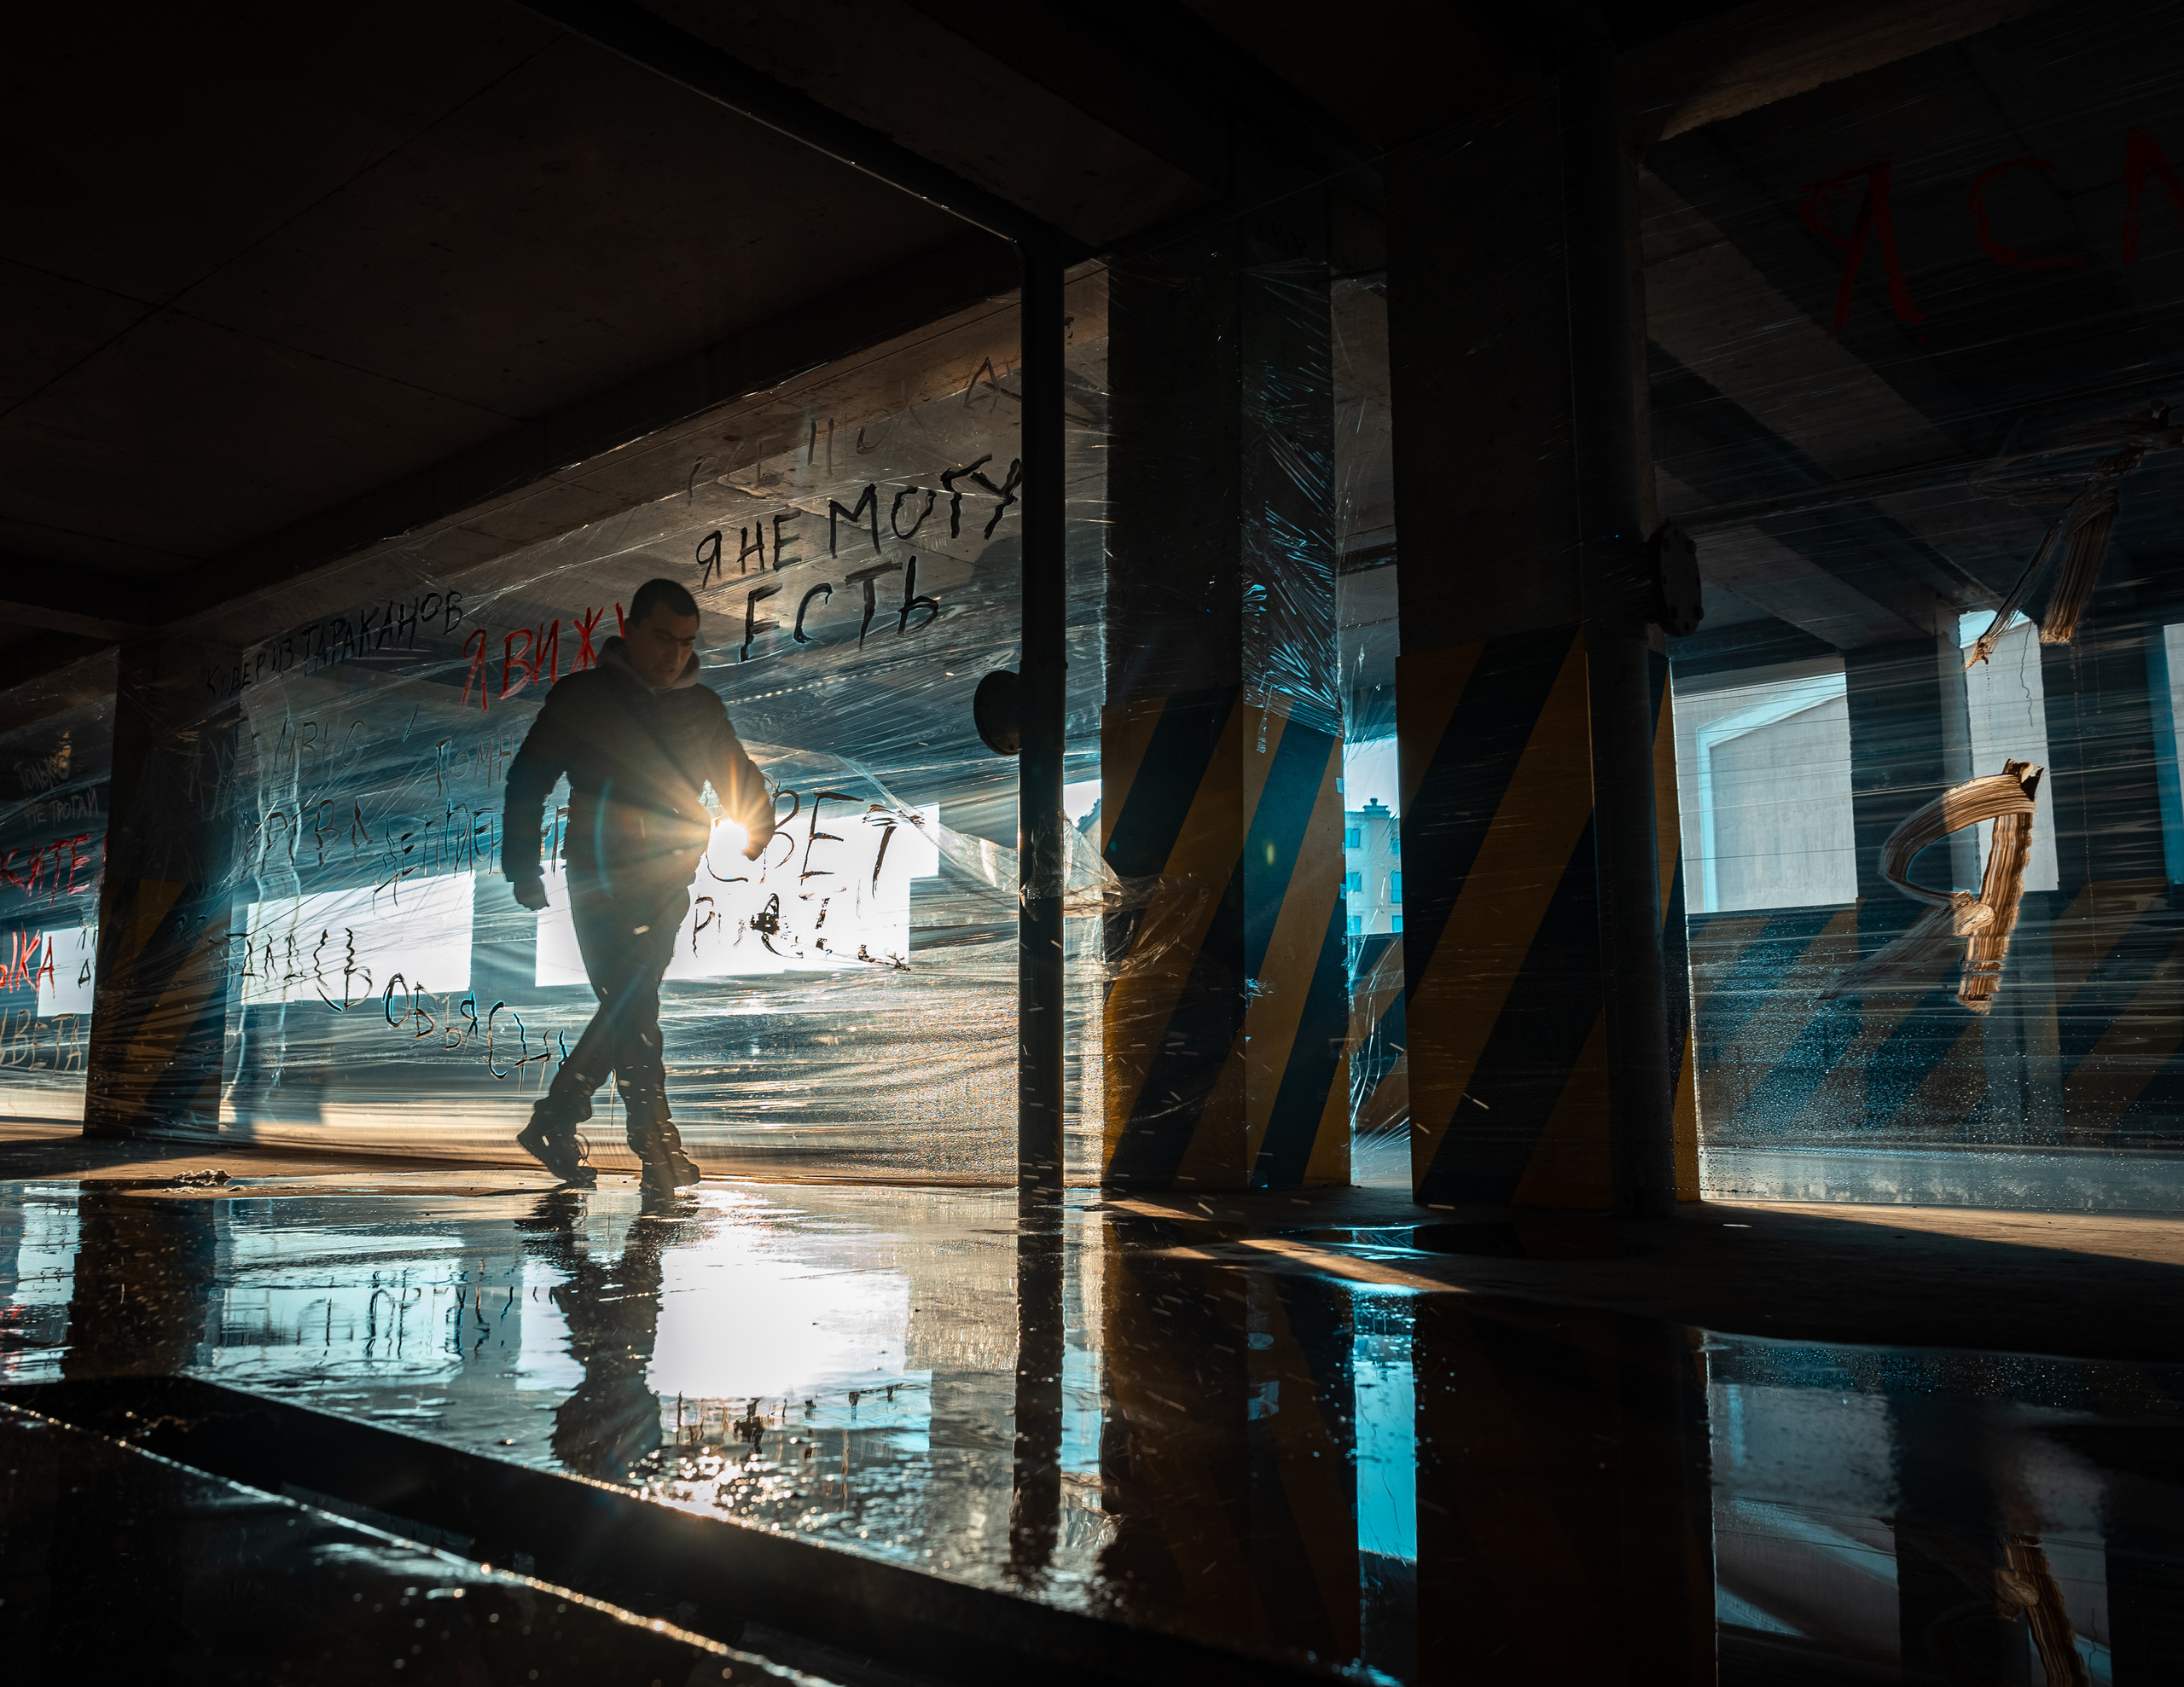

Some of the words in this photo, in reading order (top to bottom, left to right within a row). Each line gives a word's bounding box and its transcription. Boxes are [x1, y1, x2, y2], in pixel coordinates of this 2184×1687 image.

[1798, 150, 1926, 345] Я
[696, 530, 723, 590] Я
[736, 509, 804, 575] НЕ
[828, 454, 1023, 561] МОГУ
[270, 636, 294, 679] ИЗ
[300, 587, 464, 678] ТАРАКАНОВ
[739, 554, 940, 664] ЕСТЬ
[462, 628, 491, 712] Я
[50, 786, 100, 828] ТРОГАЙ
[435, 731, 526, 798] ПОМН
